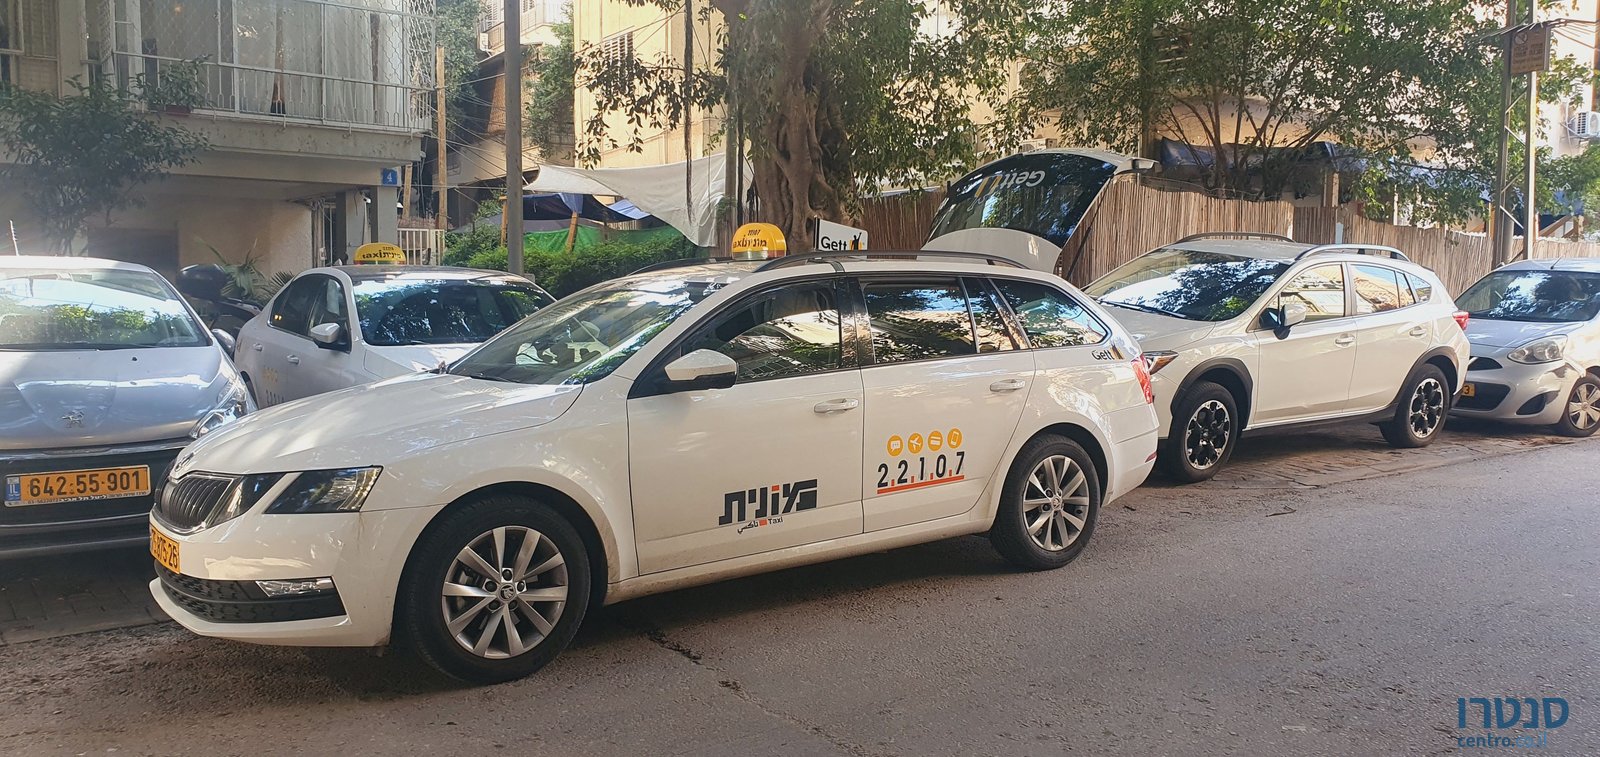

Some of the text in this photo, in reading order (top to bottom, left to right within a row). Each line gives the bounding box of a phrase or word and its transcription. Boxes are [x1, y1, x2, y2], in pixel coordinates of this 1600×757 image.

[386, 171, 393, 183] 4
[1000, 170, 1045, 189] Gett
[820, 236, 848, 251] Gett
[362, 250, 382, 259] taxi
[1091, 349, 1115, 361] Gett
[718, 479, 818, 526] מונית
[767, 516, 784, 525] Taxi
